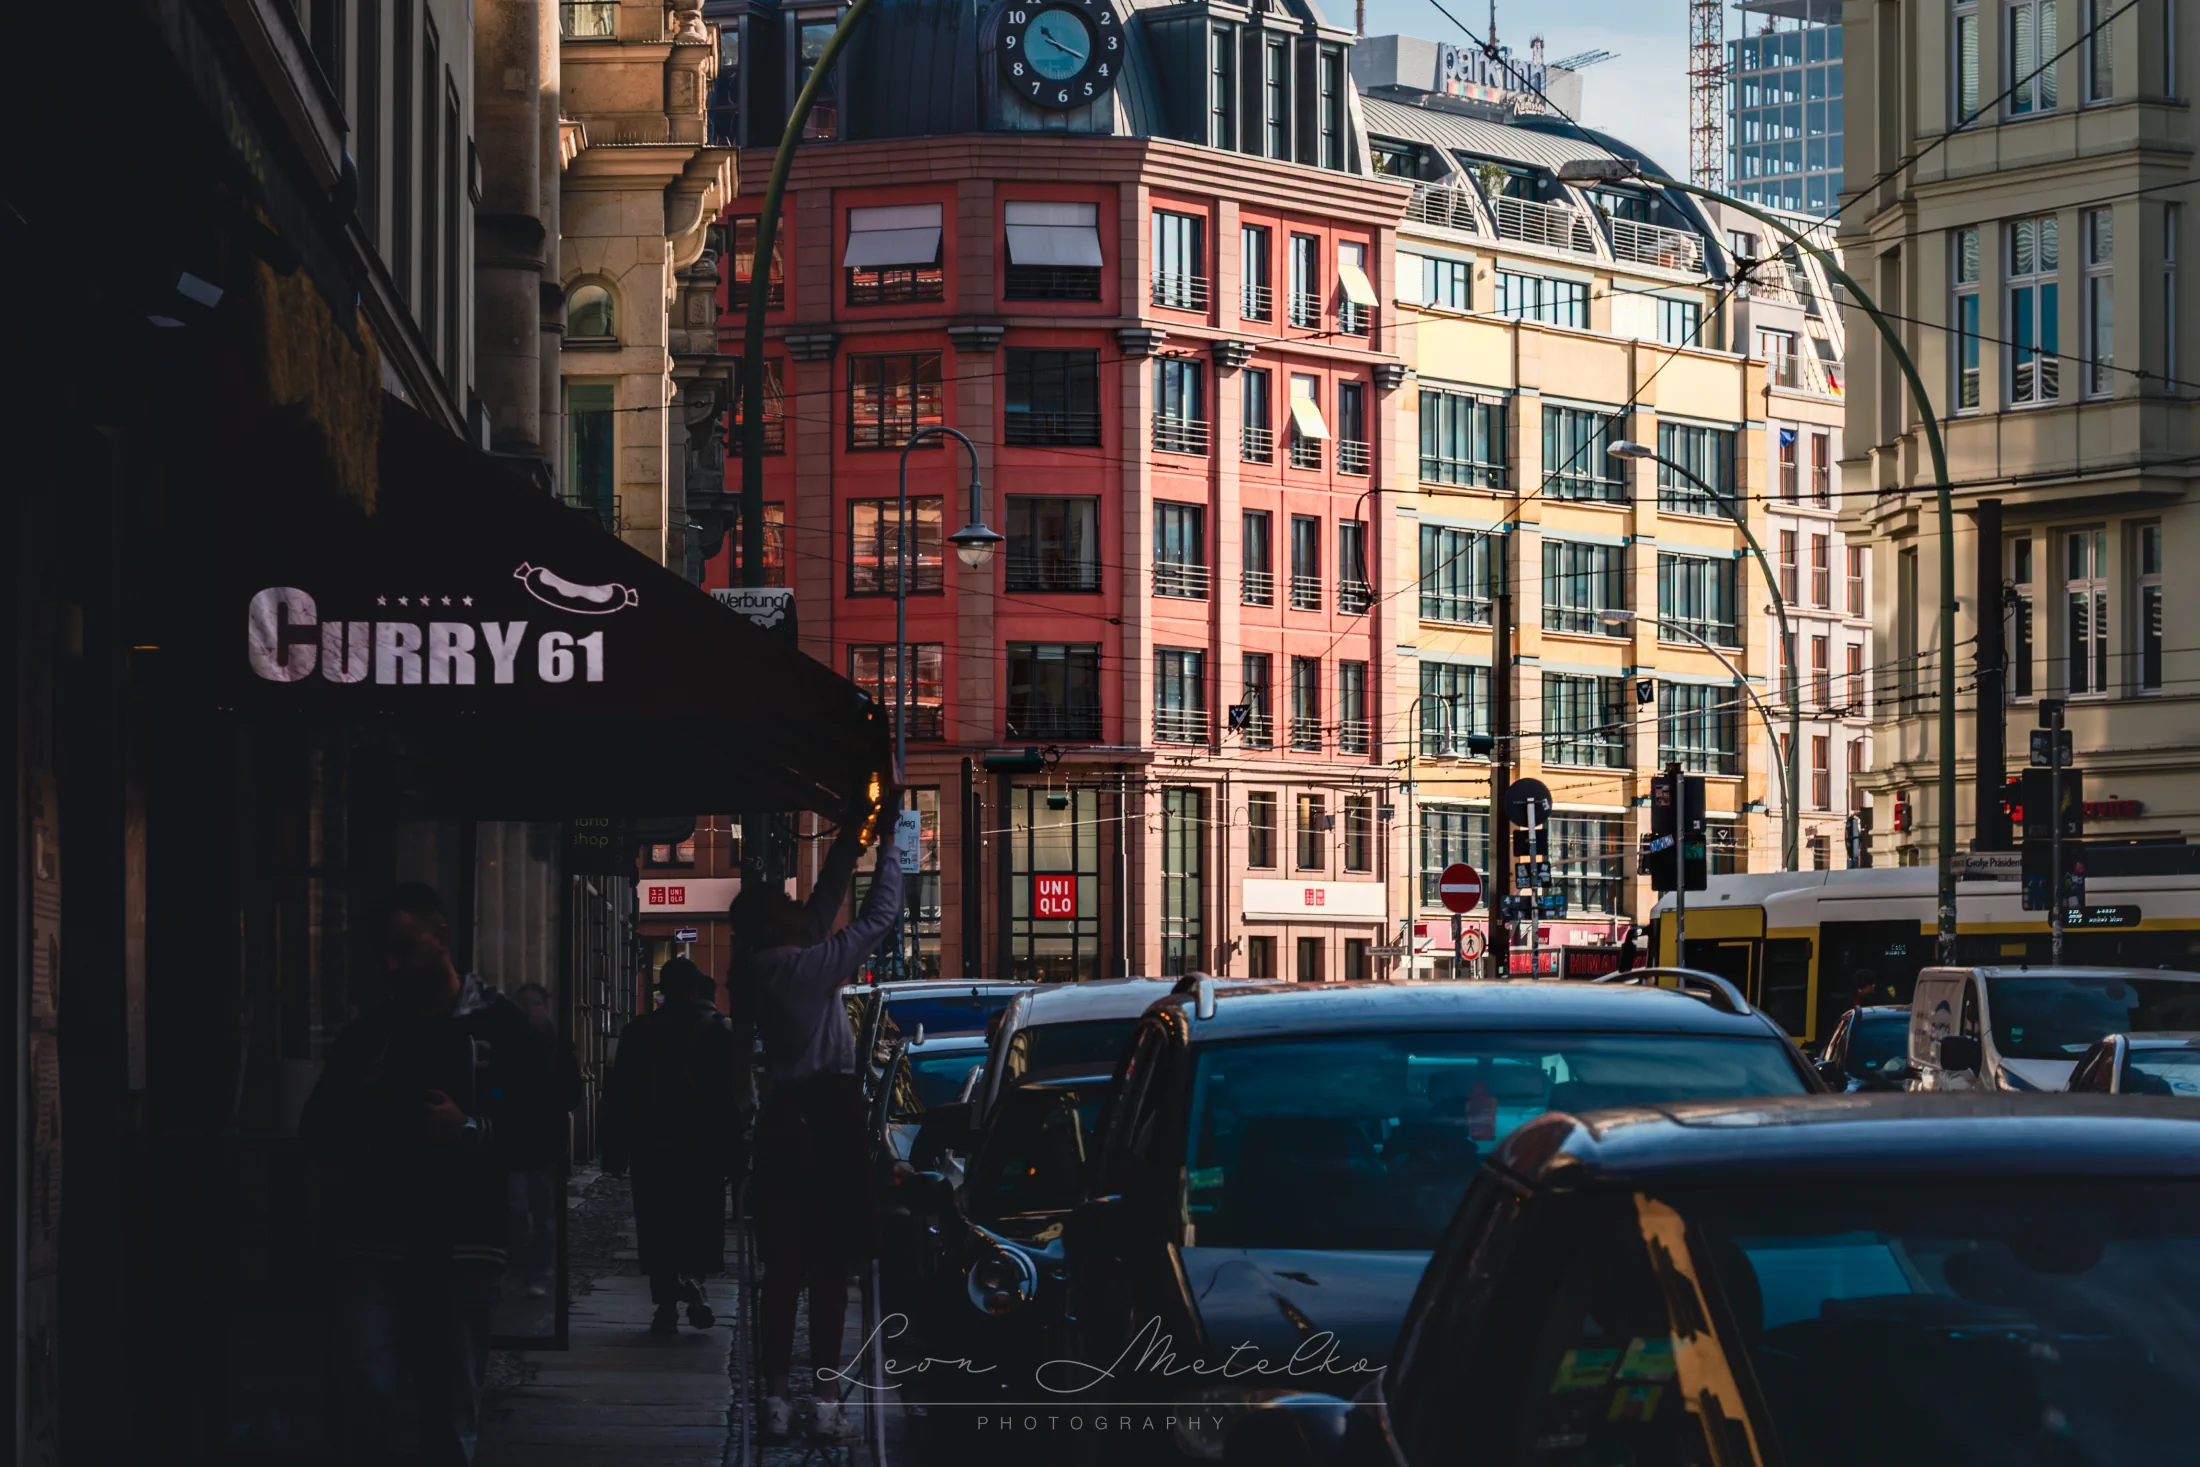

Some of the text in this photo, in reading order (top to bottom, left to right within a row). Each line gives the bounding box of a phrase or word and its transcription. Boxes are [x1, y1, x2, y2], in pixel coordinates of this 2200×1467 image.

[1008, 11, 1026, 24] 10
[1101, 12, 1110, 24] 2
[1006, 36, 1016, 48] 9
[1108, 37, 1117, 49] 3
[1013, 63, 1024, 75] 8
[1098, 63, 1108, 76] 4
[1440, 44, 1501, 93] park
[1032, 82, 1041, 95] 7
[1084, 83, 1092, 95] 5
[1058, 90, 1067, 102] 6
[536, 630, 605, 684] 61
[2082, 794, 2136, 818] ervice
[1990, 857, 2023, 868] Präsident
[1040, 880, 1068, 895] UNI
[1040, 898, 1071, 915] QLO
